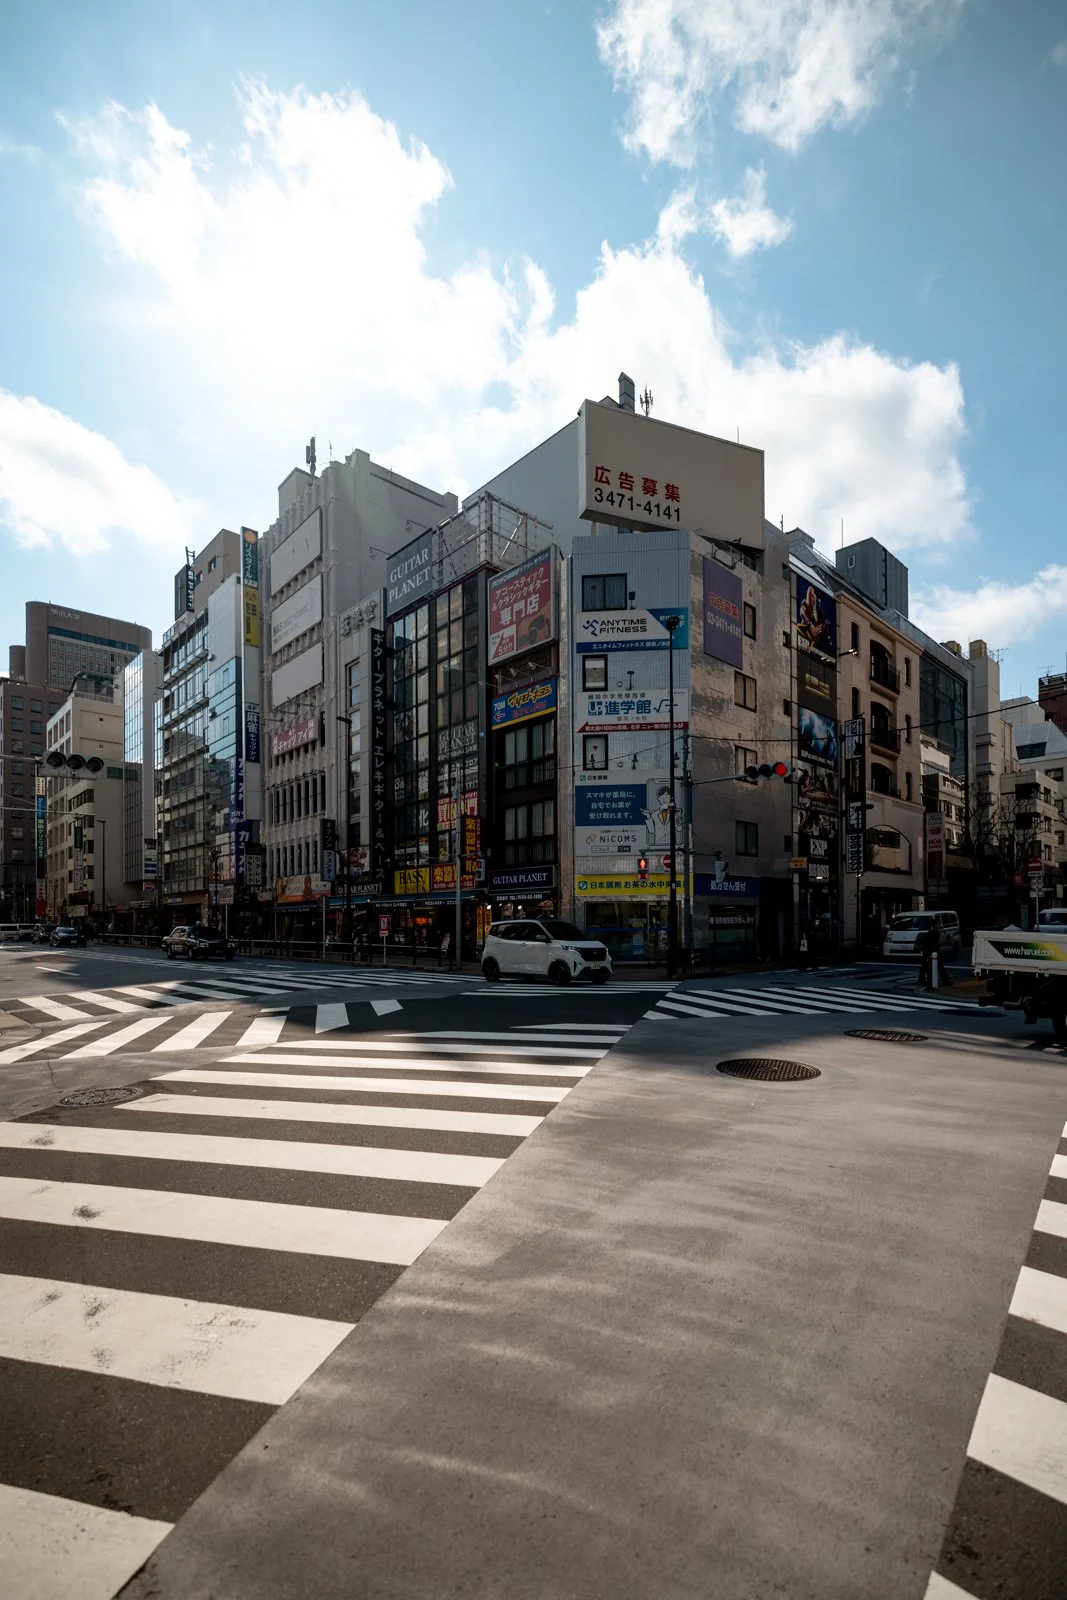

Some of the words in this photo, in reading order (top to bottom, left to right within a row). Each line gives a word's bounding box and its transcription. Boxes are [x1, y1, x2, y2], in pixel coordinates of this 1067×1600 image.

[594, 466, 680, 502] 広告募集
[594, 487, 681, 522] 3471-4141
[390, 548, 429, 583] GUITAR
[389, 566, 431, 601] PLANET
[495, 567, 545, 599] アコースティック
[50, 607, 81, 620] 明治大学
[500, 594, 540, 626] 専門店
[709, 592, 740, 620] 広告募集
[599, 618, 648, 627] ANYTIME
[599, 626, 648, 635] FITNESS
[707, 611, 741, 640] 03-3471-4141
[592, 642, 645, 650] エニタイムフィットネス
[374, 633, 385, 739] ギタープラネット
[605, 699, 652, 716] 進学館
[246, 712, 259, 734] 麻雀
[439, 722, 477, 743] GUITAR
[439, 733, 475, 754] PLANET
[586, 791, 635, 799] スマホが薬局に。
[591, 801, 632, 810] 自宅でお薬が
[589, 812, 633, 820] 受け取れます。
[599, 835, 637, 843] NiCOMS
[400, 869, 425, 886] BASS
[493, 875, 518, 885] GUITAR
[518, 872, 548, 883] PLANET
[590, 881, 622, 890] 日本調剤
[624, 880, 686, 889] お茶の水中央薬
